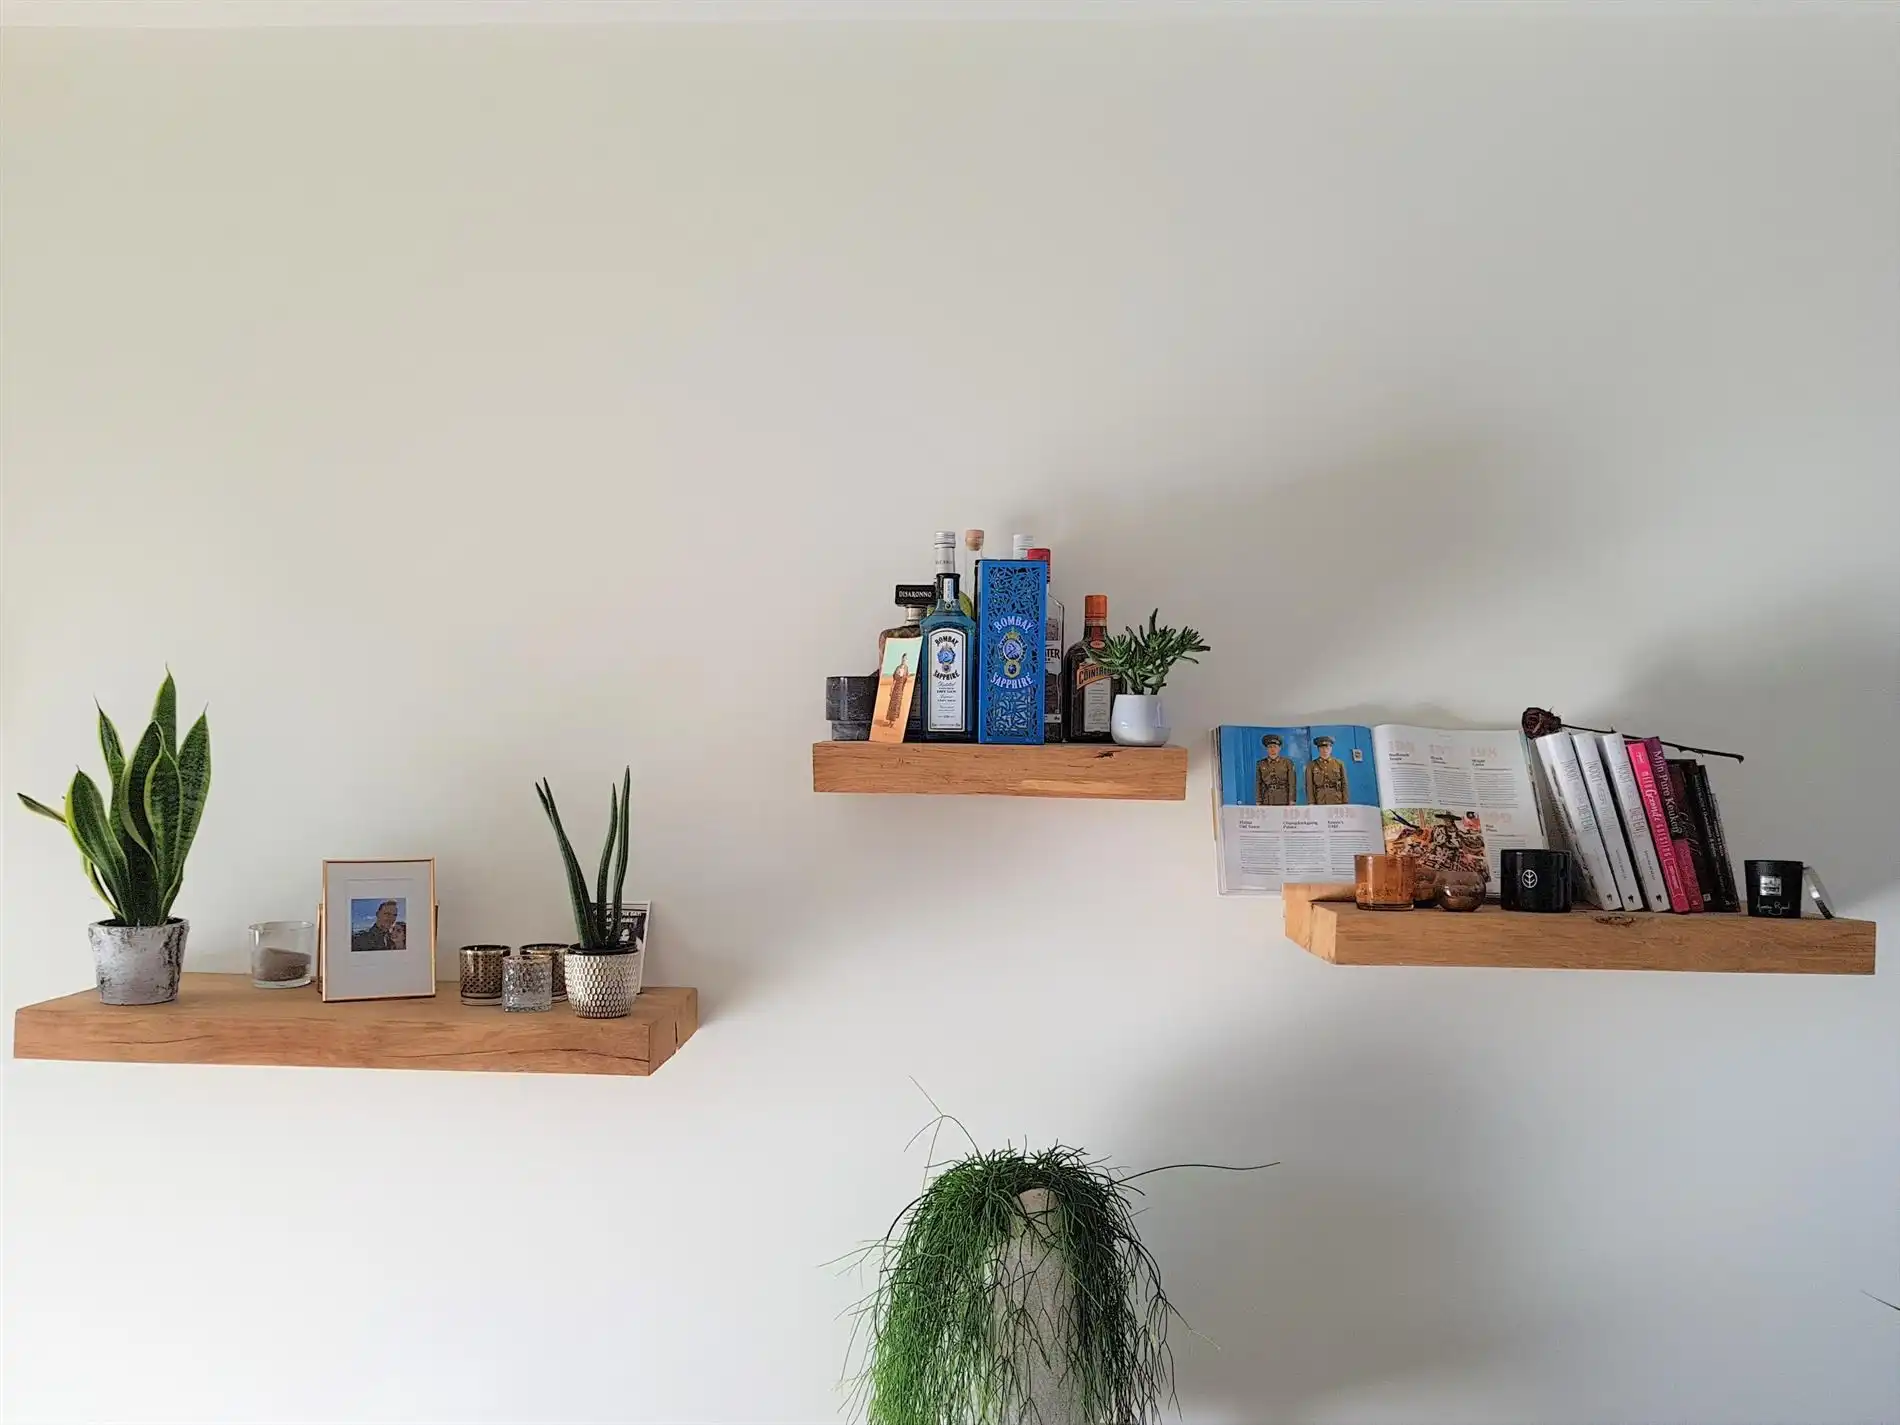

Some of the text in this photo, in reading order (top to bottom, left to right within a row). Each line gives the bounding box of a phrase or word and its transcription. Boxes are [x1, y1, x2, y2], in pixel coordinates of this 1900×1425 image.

[898, 590, 932, 598] DISARONNO
[993, 615, 1034, 634] BOMBAY
[934, 635, 959, 647] BOMBAY
[933, 669, 960, 680] SAPPHIRE
[990, 671, 1035, 690] SAPPHIRE
[1652, 751, 1665, 772] Mijn
[1660, 773, 1671, 795] Pure
